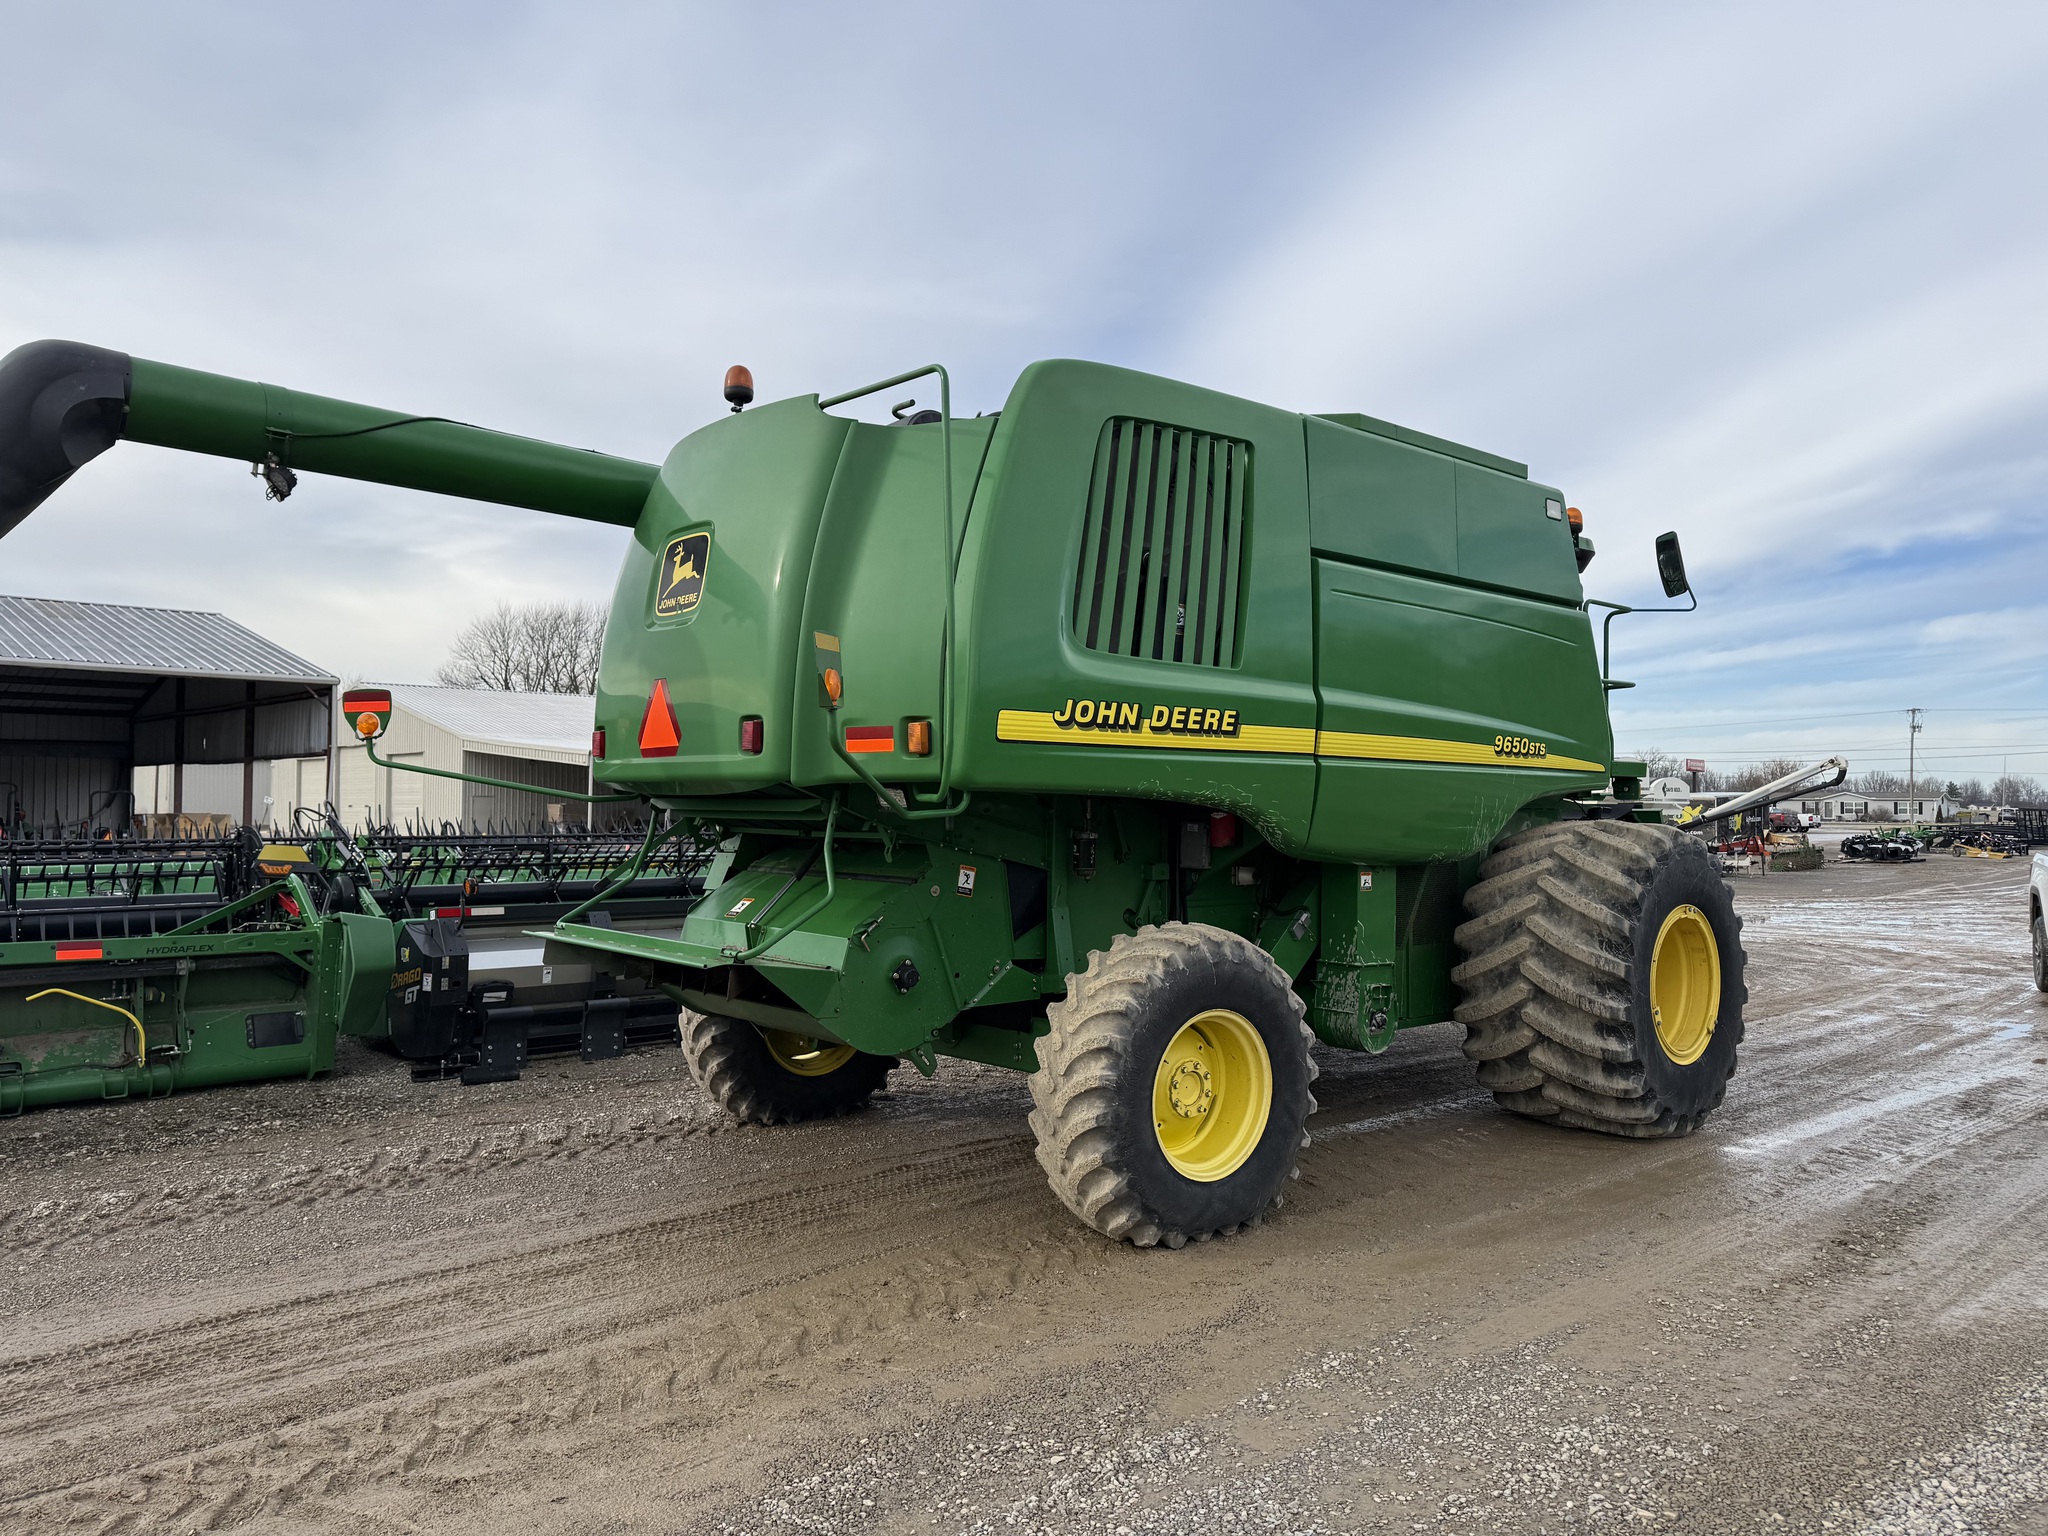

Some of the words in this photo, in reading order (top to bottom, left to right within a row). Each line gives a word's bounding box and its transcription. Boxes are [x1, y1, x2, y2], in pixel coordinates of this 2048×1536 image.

[659, 597, 677, 610] JOHN
[677, 592, 698, 605] DEERE
[1053, 698, 1142, 731] JOHN
[1150, 704, 1240, 736] DEERE
[1494, 735, 1547, 757] 9650STS
[146, 944, 215, 955] HYDRAFLEX
[390, 967, 421, 990] DRAGO
[404, 985, 420, 1005] GT
